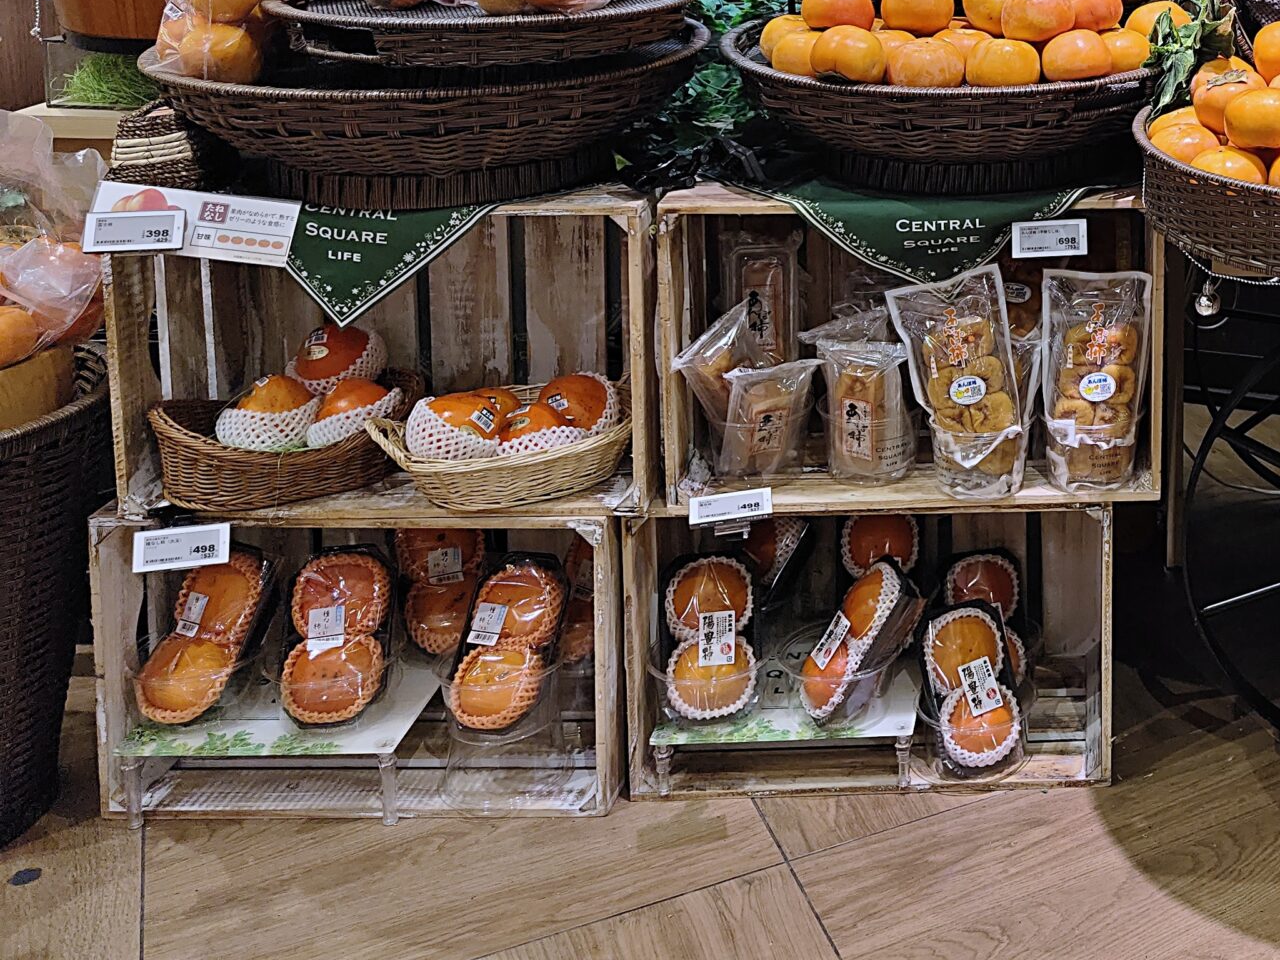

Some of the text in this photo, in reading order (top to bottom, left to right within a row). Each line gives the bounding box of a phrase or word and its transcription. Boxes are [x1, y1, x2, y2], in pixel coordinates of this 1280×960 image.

[205, 203, 224, 213] たね
[304, 203, 398, 221] CENTRAL
[203, 211, 223, 221] なし
[229, 215, 286, 228] ゼリーのような食感に
[895, 218, 986, 232] CENTRAL
[146, 229, 170, 238] 398
[196, 233, 211, 241] 甘味
[305, 222, 388, 245] SQUARE
[903, 235, 981, 248] SQUARE
[1058, 237, 1077, 245] 698
[927, 246, 959, 255] LIFE
[327, 250, 362, 262] LIFE
[740, 501, 760, 510] 498
[192, 544, 215, 554] 498
